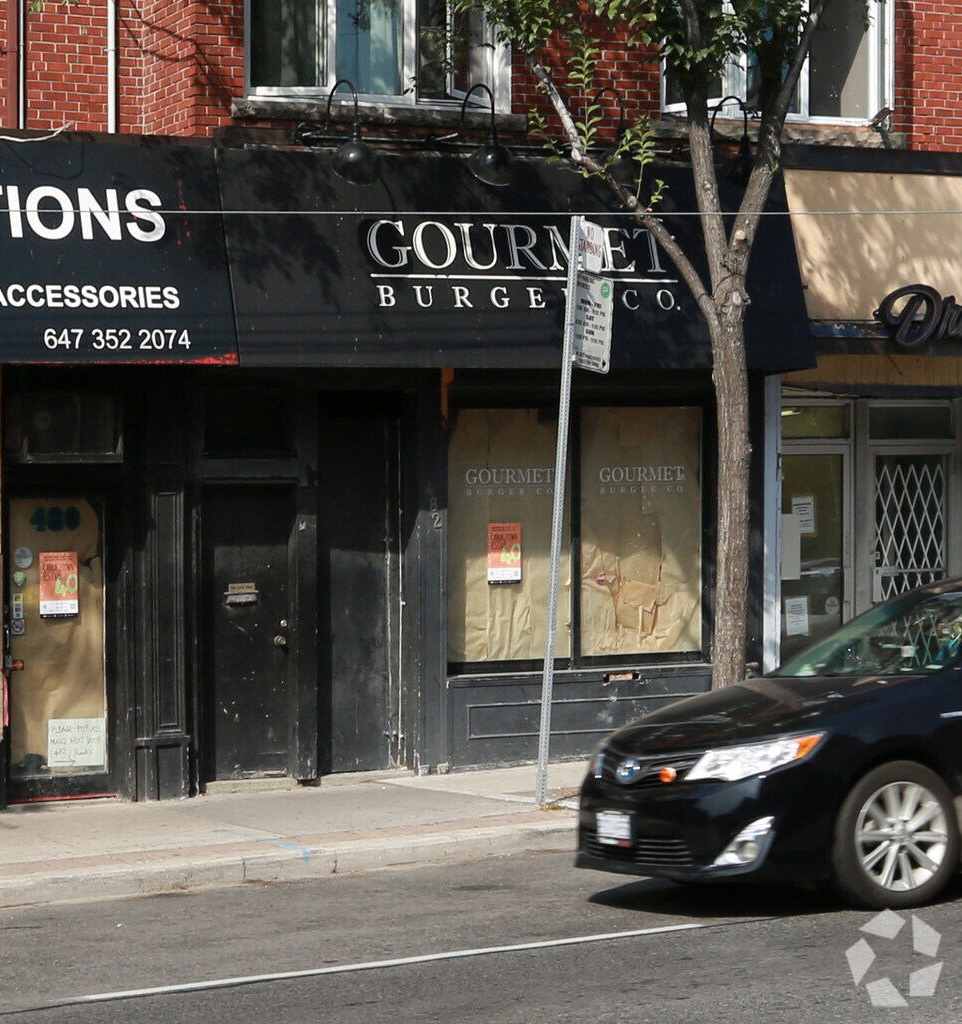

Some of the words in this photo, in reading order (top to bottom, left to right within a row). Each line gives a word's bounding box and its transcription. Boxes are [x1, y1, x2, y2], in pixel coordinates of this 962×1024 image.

[586, 226, 595, 241] NO
[376, 284, 569, 310] BURGE
[621, 288, 681, 311] CO.
[43, 328, 84, 350] 647
[91, 328, 132, 350] 352
[139, 329, 191, 351] 2074
[466, 468, 555, 484] GOURMET
[599, 466, 686, 483] GOURMET
[466, 488, 525, 497] BURGER
[600, 486, 661, 495] BURGER
[30, 505, 81, 532] 480
[55, 573, 78, 597] 40
[51, 725, 72, 733] PLEASE
